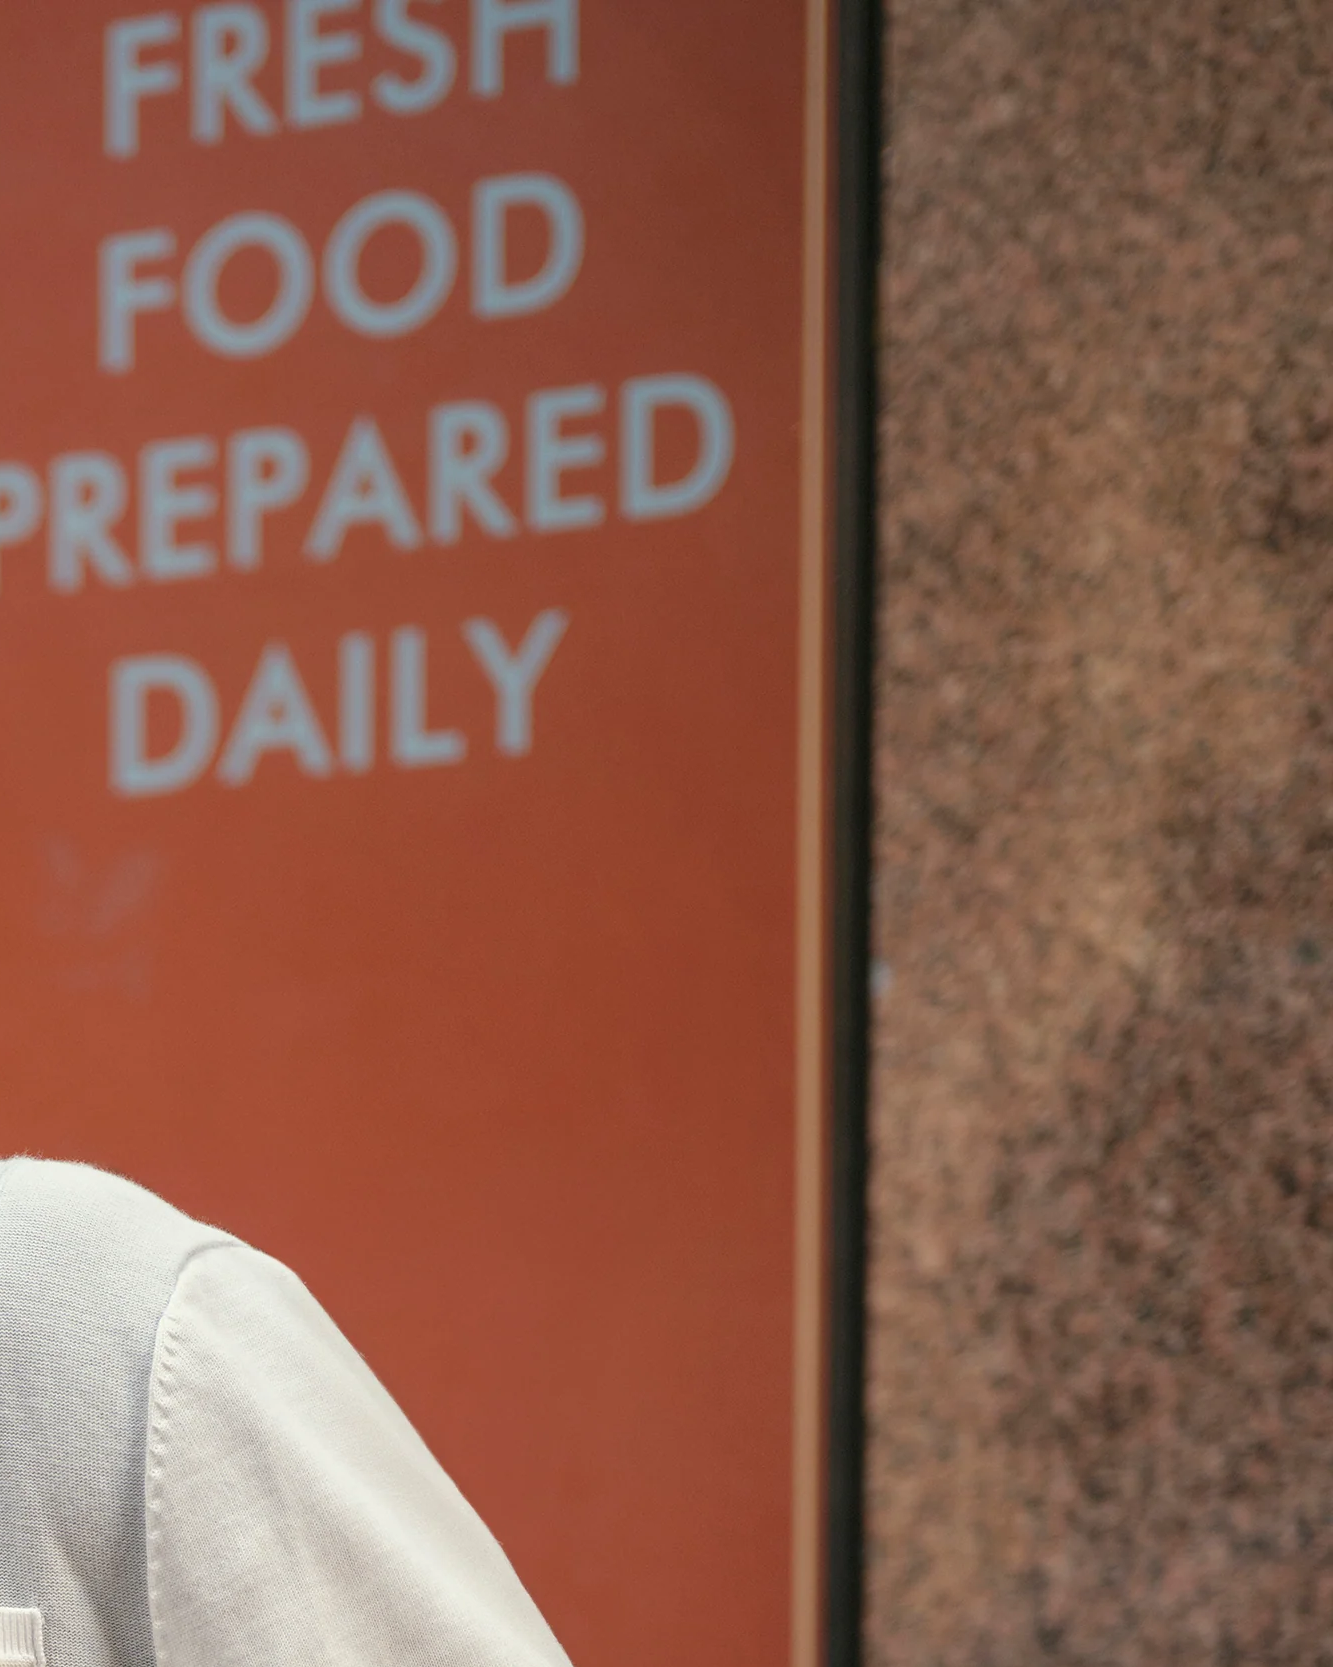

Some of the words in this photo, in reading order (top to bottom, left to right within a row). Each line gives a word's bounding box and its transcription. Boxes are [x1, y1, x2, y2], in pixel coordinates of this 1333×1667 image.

[105, 0, 579, 158] FRESH
[98, 172, 584, 374] FOOD
[108, 608, 569, 797] DAILY
